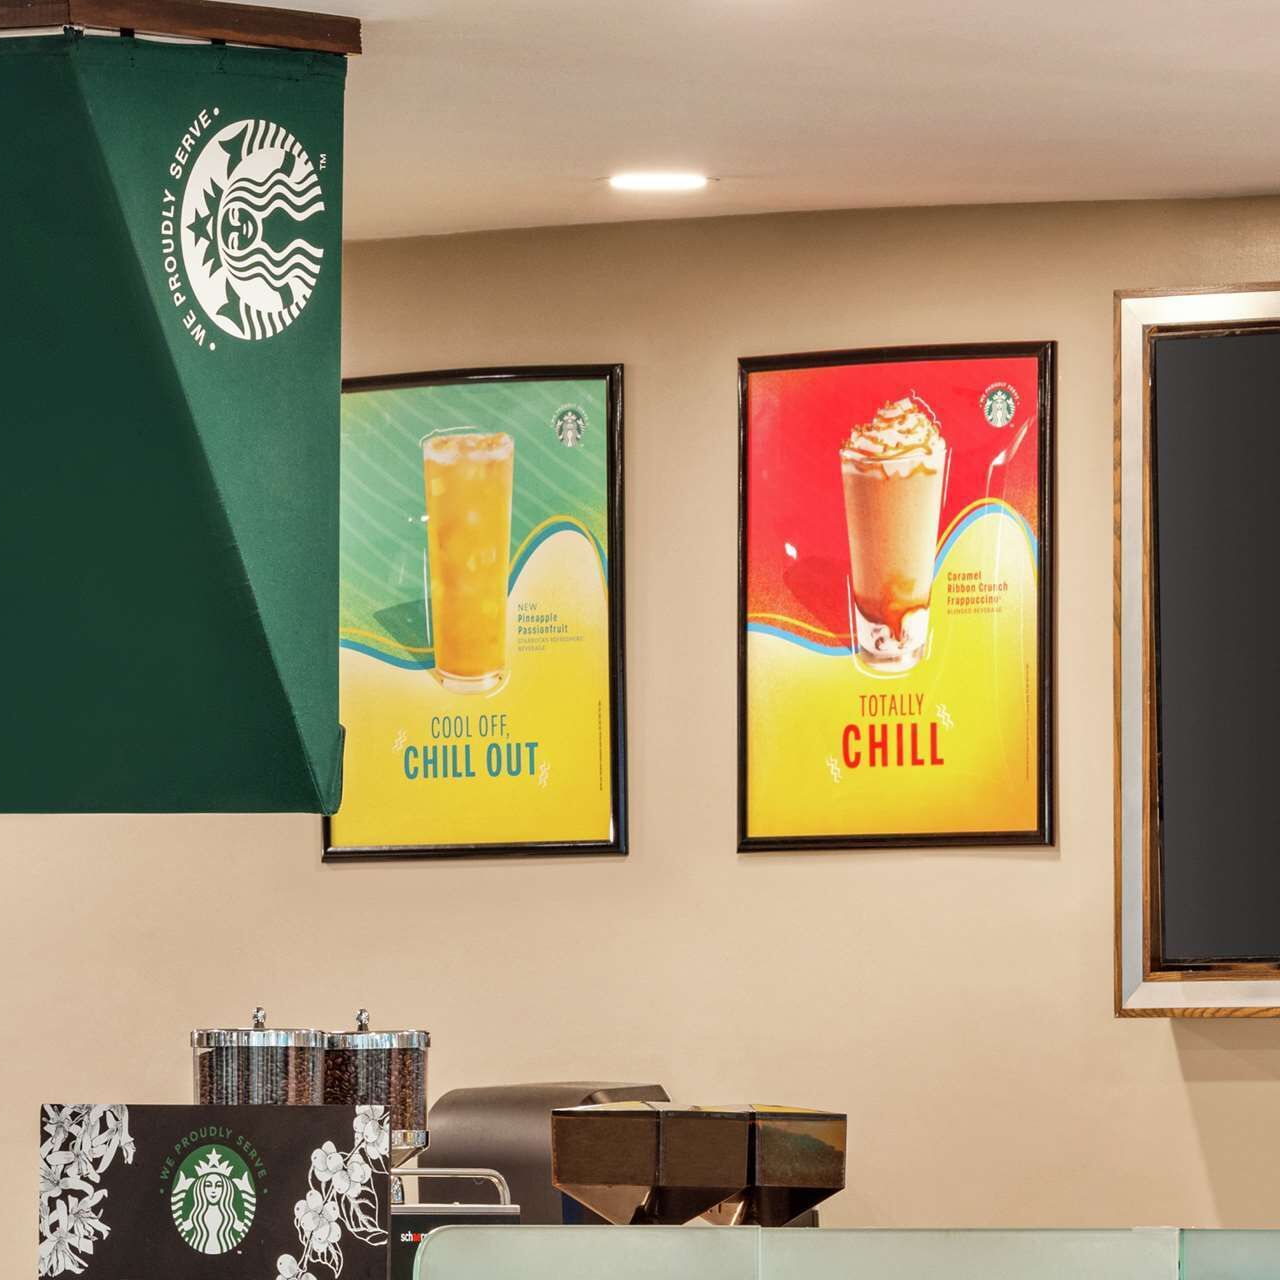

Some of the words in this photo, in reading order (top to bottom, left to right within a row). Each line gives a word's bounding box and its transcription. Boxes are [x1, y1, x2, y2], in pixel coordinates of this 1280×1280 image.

[169, 109, 211, 180] SERVE
[161, 189, 186, 306] PROUDLY
[182, 310, 206, 346] WE
[947, 570, 982, 581] Caramel
[947, 583, 976, 593] Ribbon
[518, 613, 558, 623] Pineapple
[518, 624, 568, 634] Passionfruit
[859, 694, 924, 717] TOTALLY
[431, 715, 473, 739] COOL
[479, 714, 510, 738] OFF,
[404, 745, 476, 779] CHILL
[486, 742, 539, 777] OUT
[842, 723, 944, 769] CHILL
[160, 1157, 175, 1181] WE
[174, 1126, 233, 1153] PROUDLY
[236, 1135, 268, 1179] SERVE
